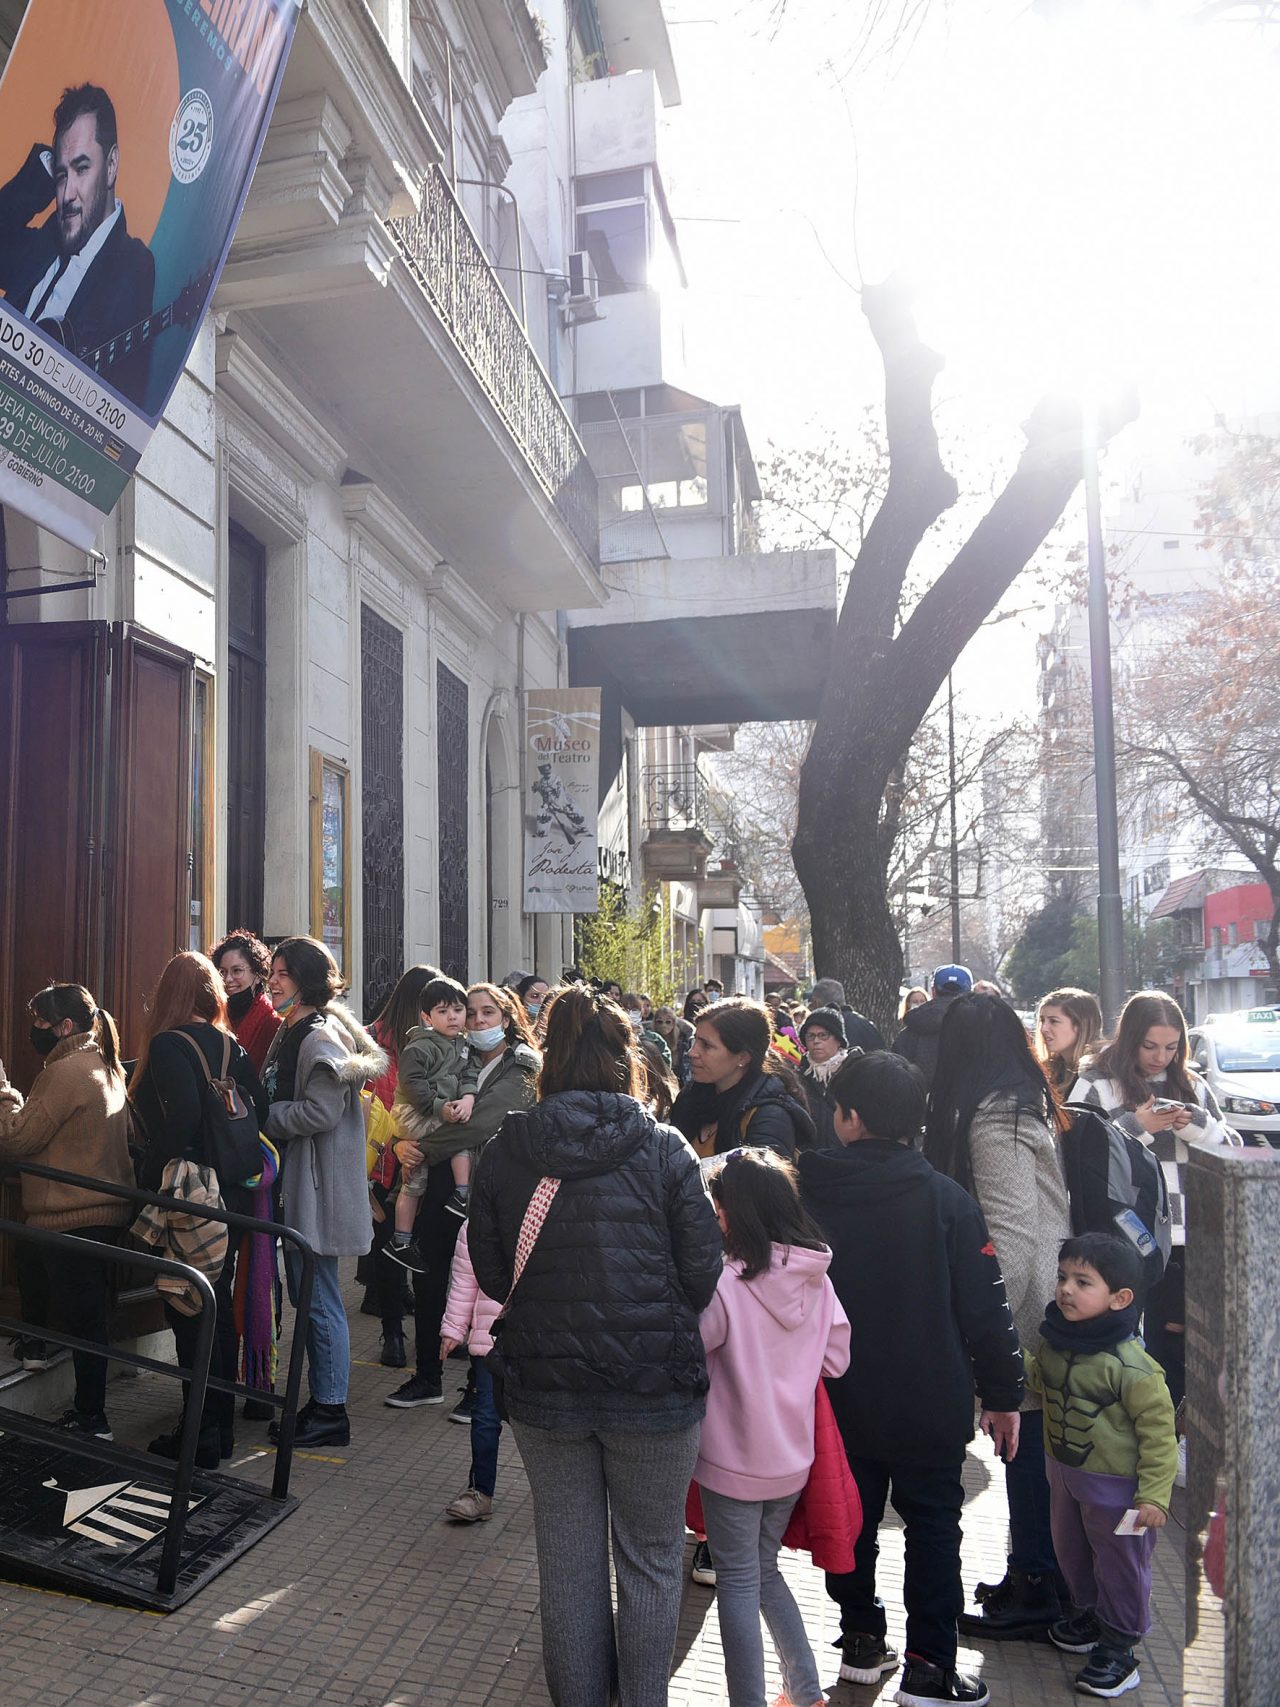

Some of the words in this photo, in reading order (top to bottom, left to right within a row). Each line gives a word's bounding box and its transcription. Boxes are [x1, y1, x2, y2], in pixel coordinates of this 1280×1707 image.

[177, 118, 208, 153] 25
[24, 341, 44, 367] 30
[43, 355, 65, 382] DE
[62, 373, 98, 408] JULIO
[96, 398, 126, 430] 21:00
[18, 375, 26, 385] A
[26, 379, 61, 412] DOMINGO
[60, 403, 71, 419] DE
[71, 412, 80, 424] 15
[77, 418, 85, 428] A
[84, 422, 94, 437] 20
[93, 430, 104, 445] HS.
[25, 410, 70, 449] FUNCIÓN
[7, 459, 44, 487] GOBIERNO
[13, 428, 34, 453] DE
[31, 446, 67, 475] JULIO
[64, 465, 96, 495] 21:00
[536, 736, 591, 752] Museo
[538, 752, 550, 762] del
[552, 752, 591, 764] Teatro
[532, 841, 563, 863] José
[1251, 1012, 1273, 1021] TAXI
